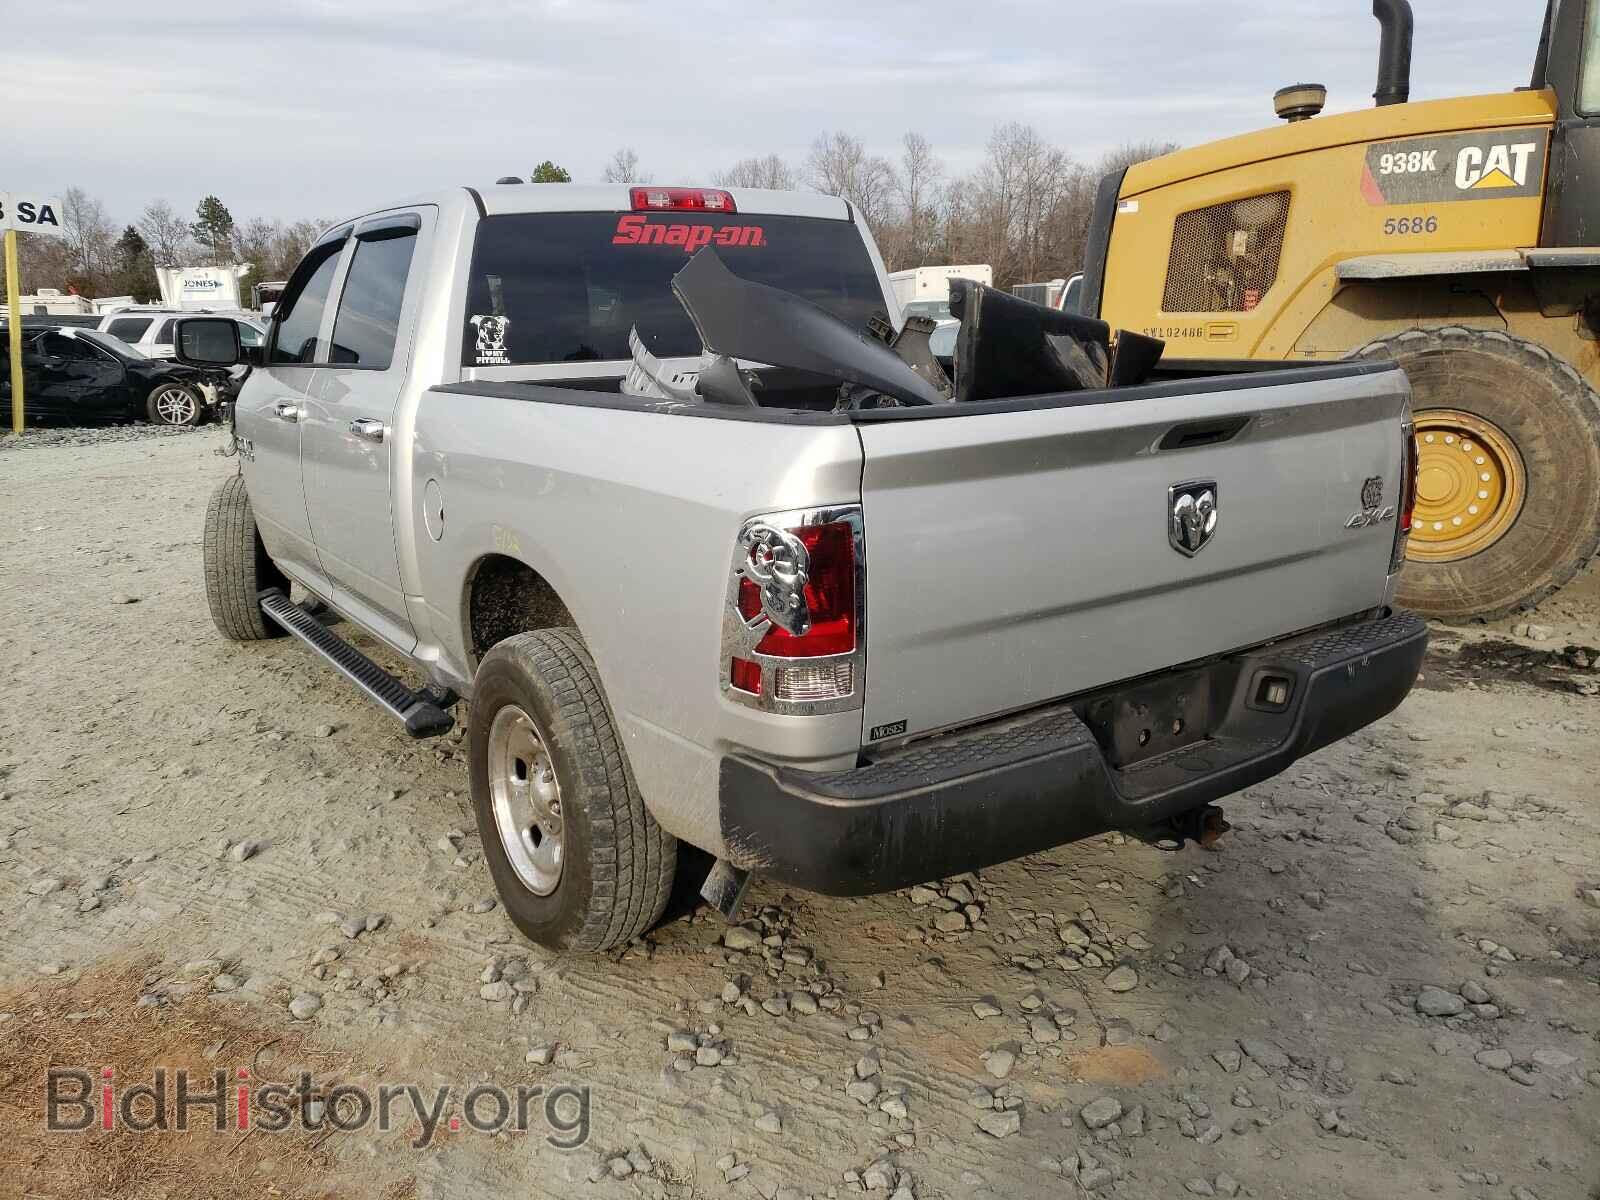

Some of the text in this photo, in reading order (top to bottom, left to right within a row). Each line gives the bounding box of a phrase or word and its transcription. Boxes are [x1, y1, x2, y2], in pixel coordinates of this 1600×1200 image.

[1379, 149, 1438, 175] 938K
[1455, 142, 1536, 190] CAT
[16, 201, 59, 226] SA
[1384, 216, 1438, 235] 5686
[612, 215, 764, 252] Snap-on
[184, 279, 214, 288] JONES
